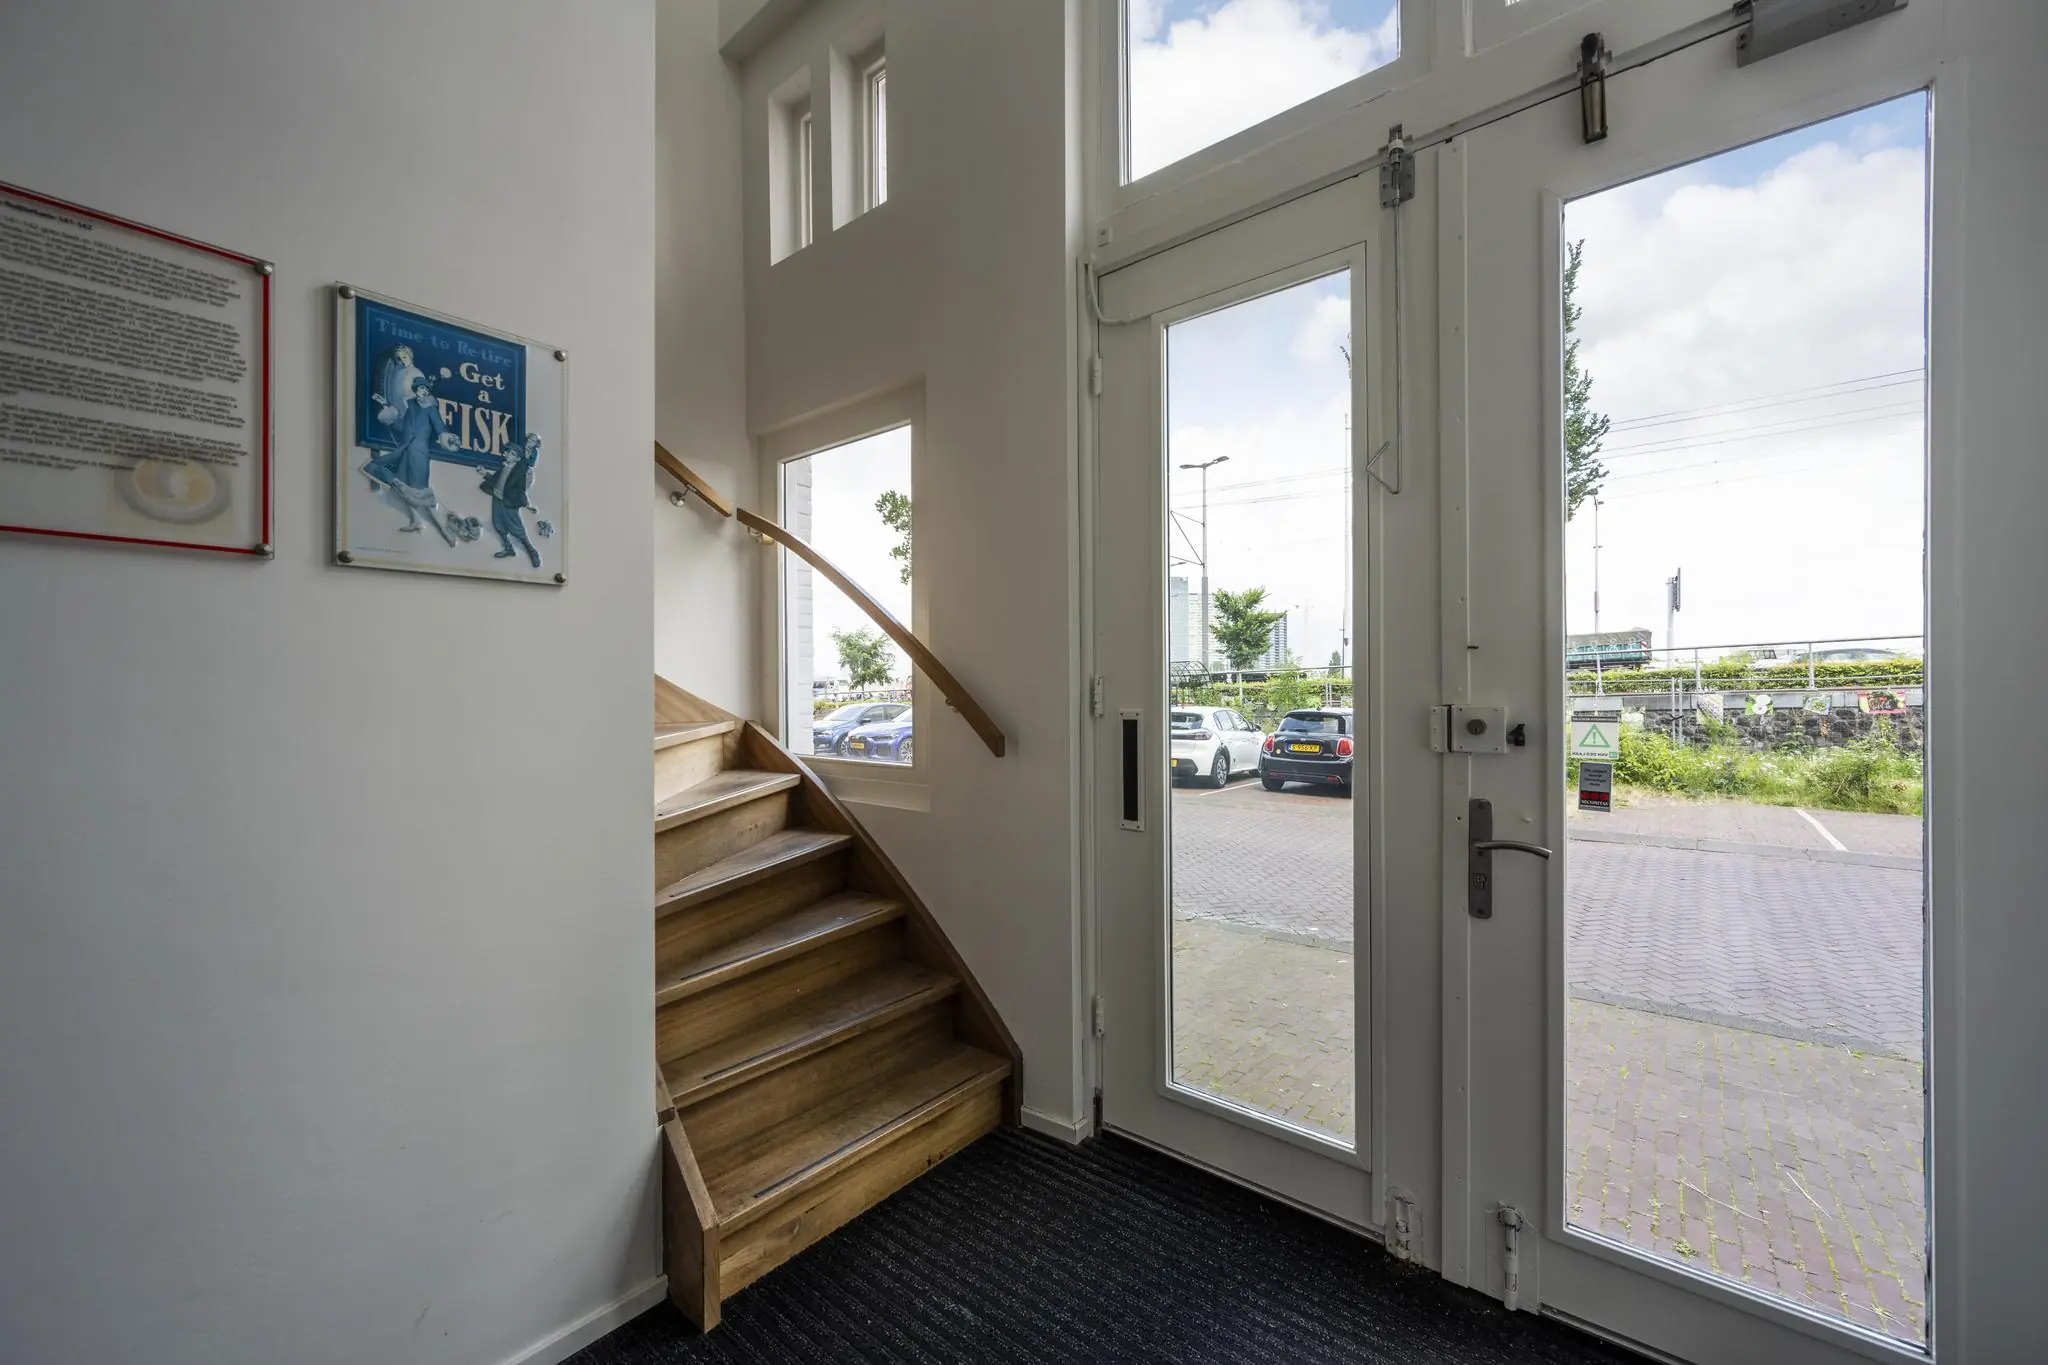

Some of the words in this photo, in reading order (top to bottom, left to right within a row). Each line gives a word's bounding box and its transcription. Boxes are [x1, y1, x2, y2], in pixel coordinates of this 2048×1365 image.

[376, 317, 424, 342] Time
[430, 335, 450, 350] to
[457, 341, 512, 367] Re-tire
[459, 362, 505, 390] Get
[478, 389, 491, 404] a
[436, 397, 513, 456] FISK
